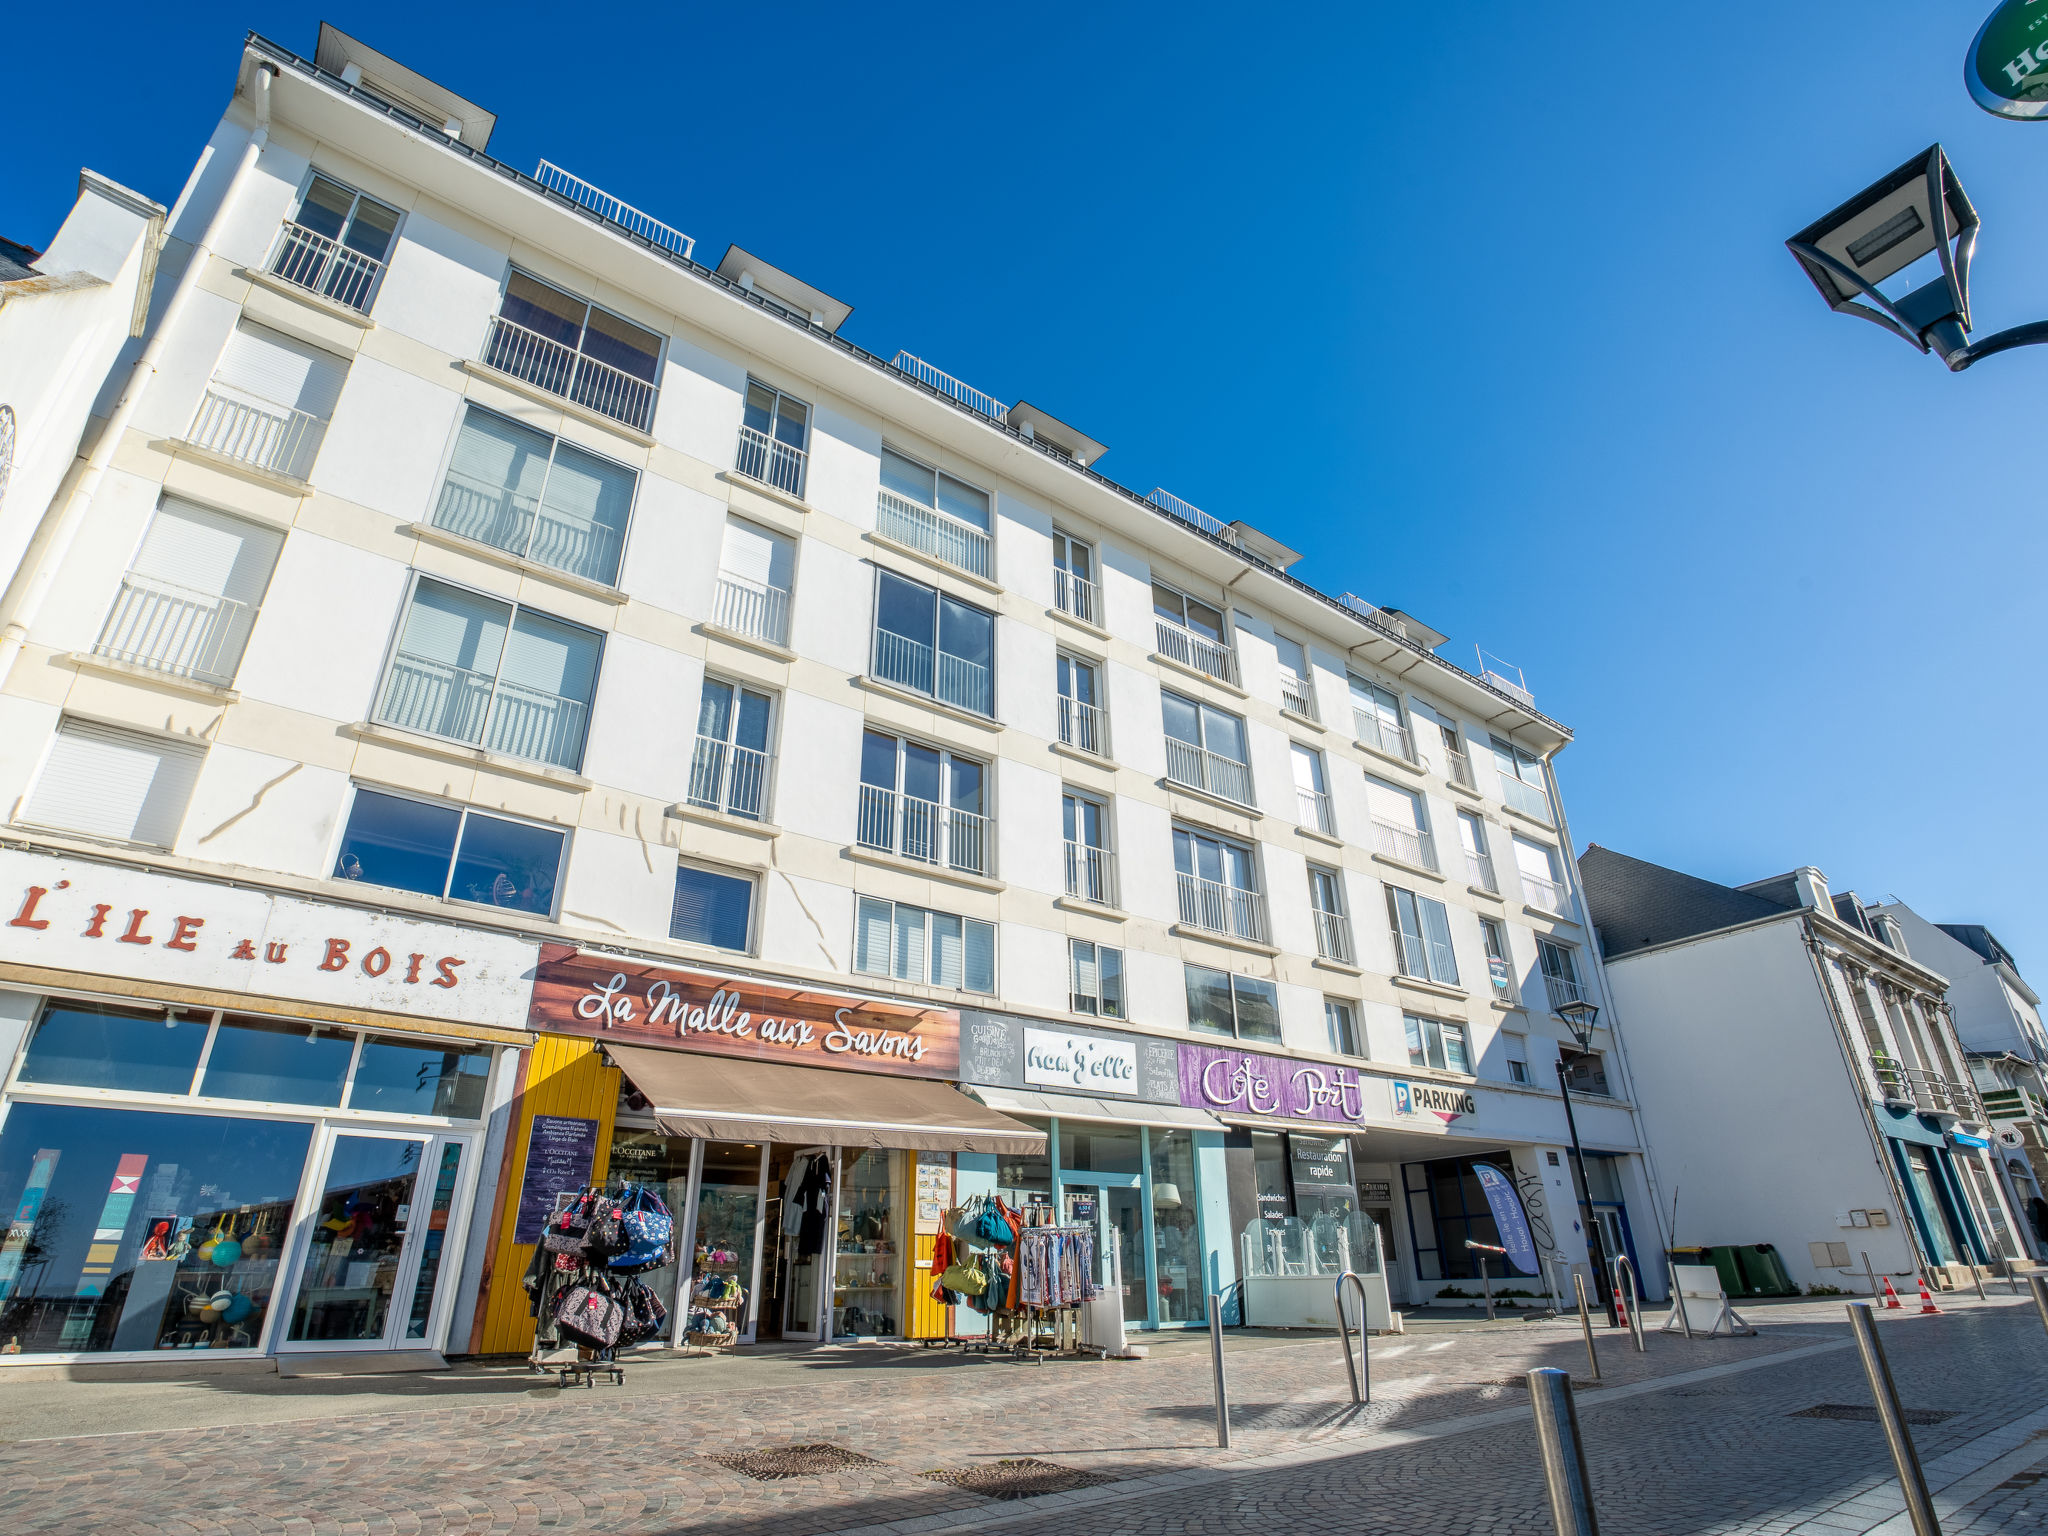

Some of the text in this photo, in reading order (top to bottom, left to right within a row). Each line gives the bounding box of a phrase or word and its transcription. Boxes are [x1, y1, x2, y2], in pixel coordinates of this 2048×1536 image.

[231, 938, 288, 964] AU
[321, 937, 467, 988] BOIS
[578, 972, 929, 1061] La Malle aux Savons
[1291, 1068, 1365, 1120] Port
[1412, 1087, 1476, 1114] PARKING
[1296, 1148, 1343, 1162] Restauration
[1309, 1165, 1334, 1178] rapide
[1257, 1193, 1287, 1202] Sandwiches
[1264, 1210, 1284, 1219] Salades
